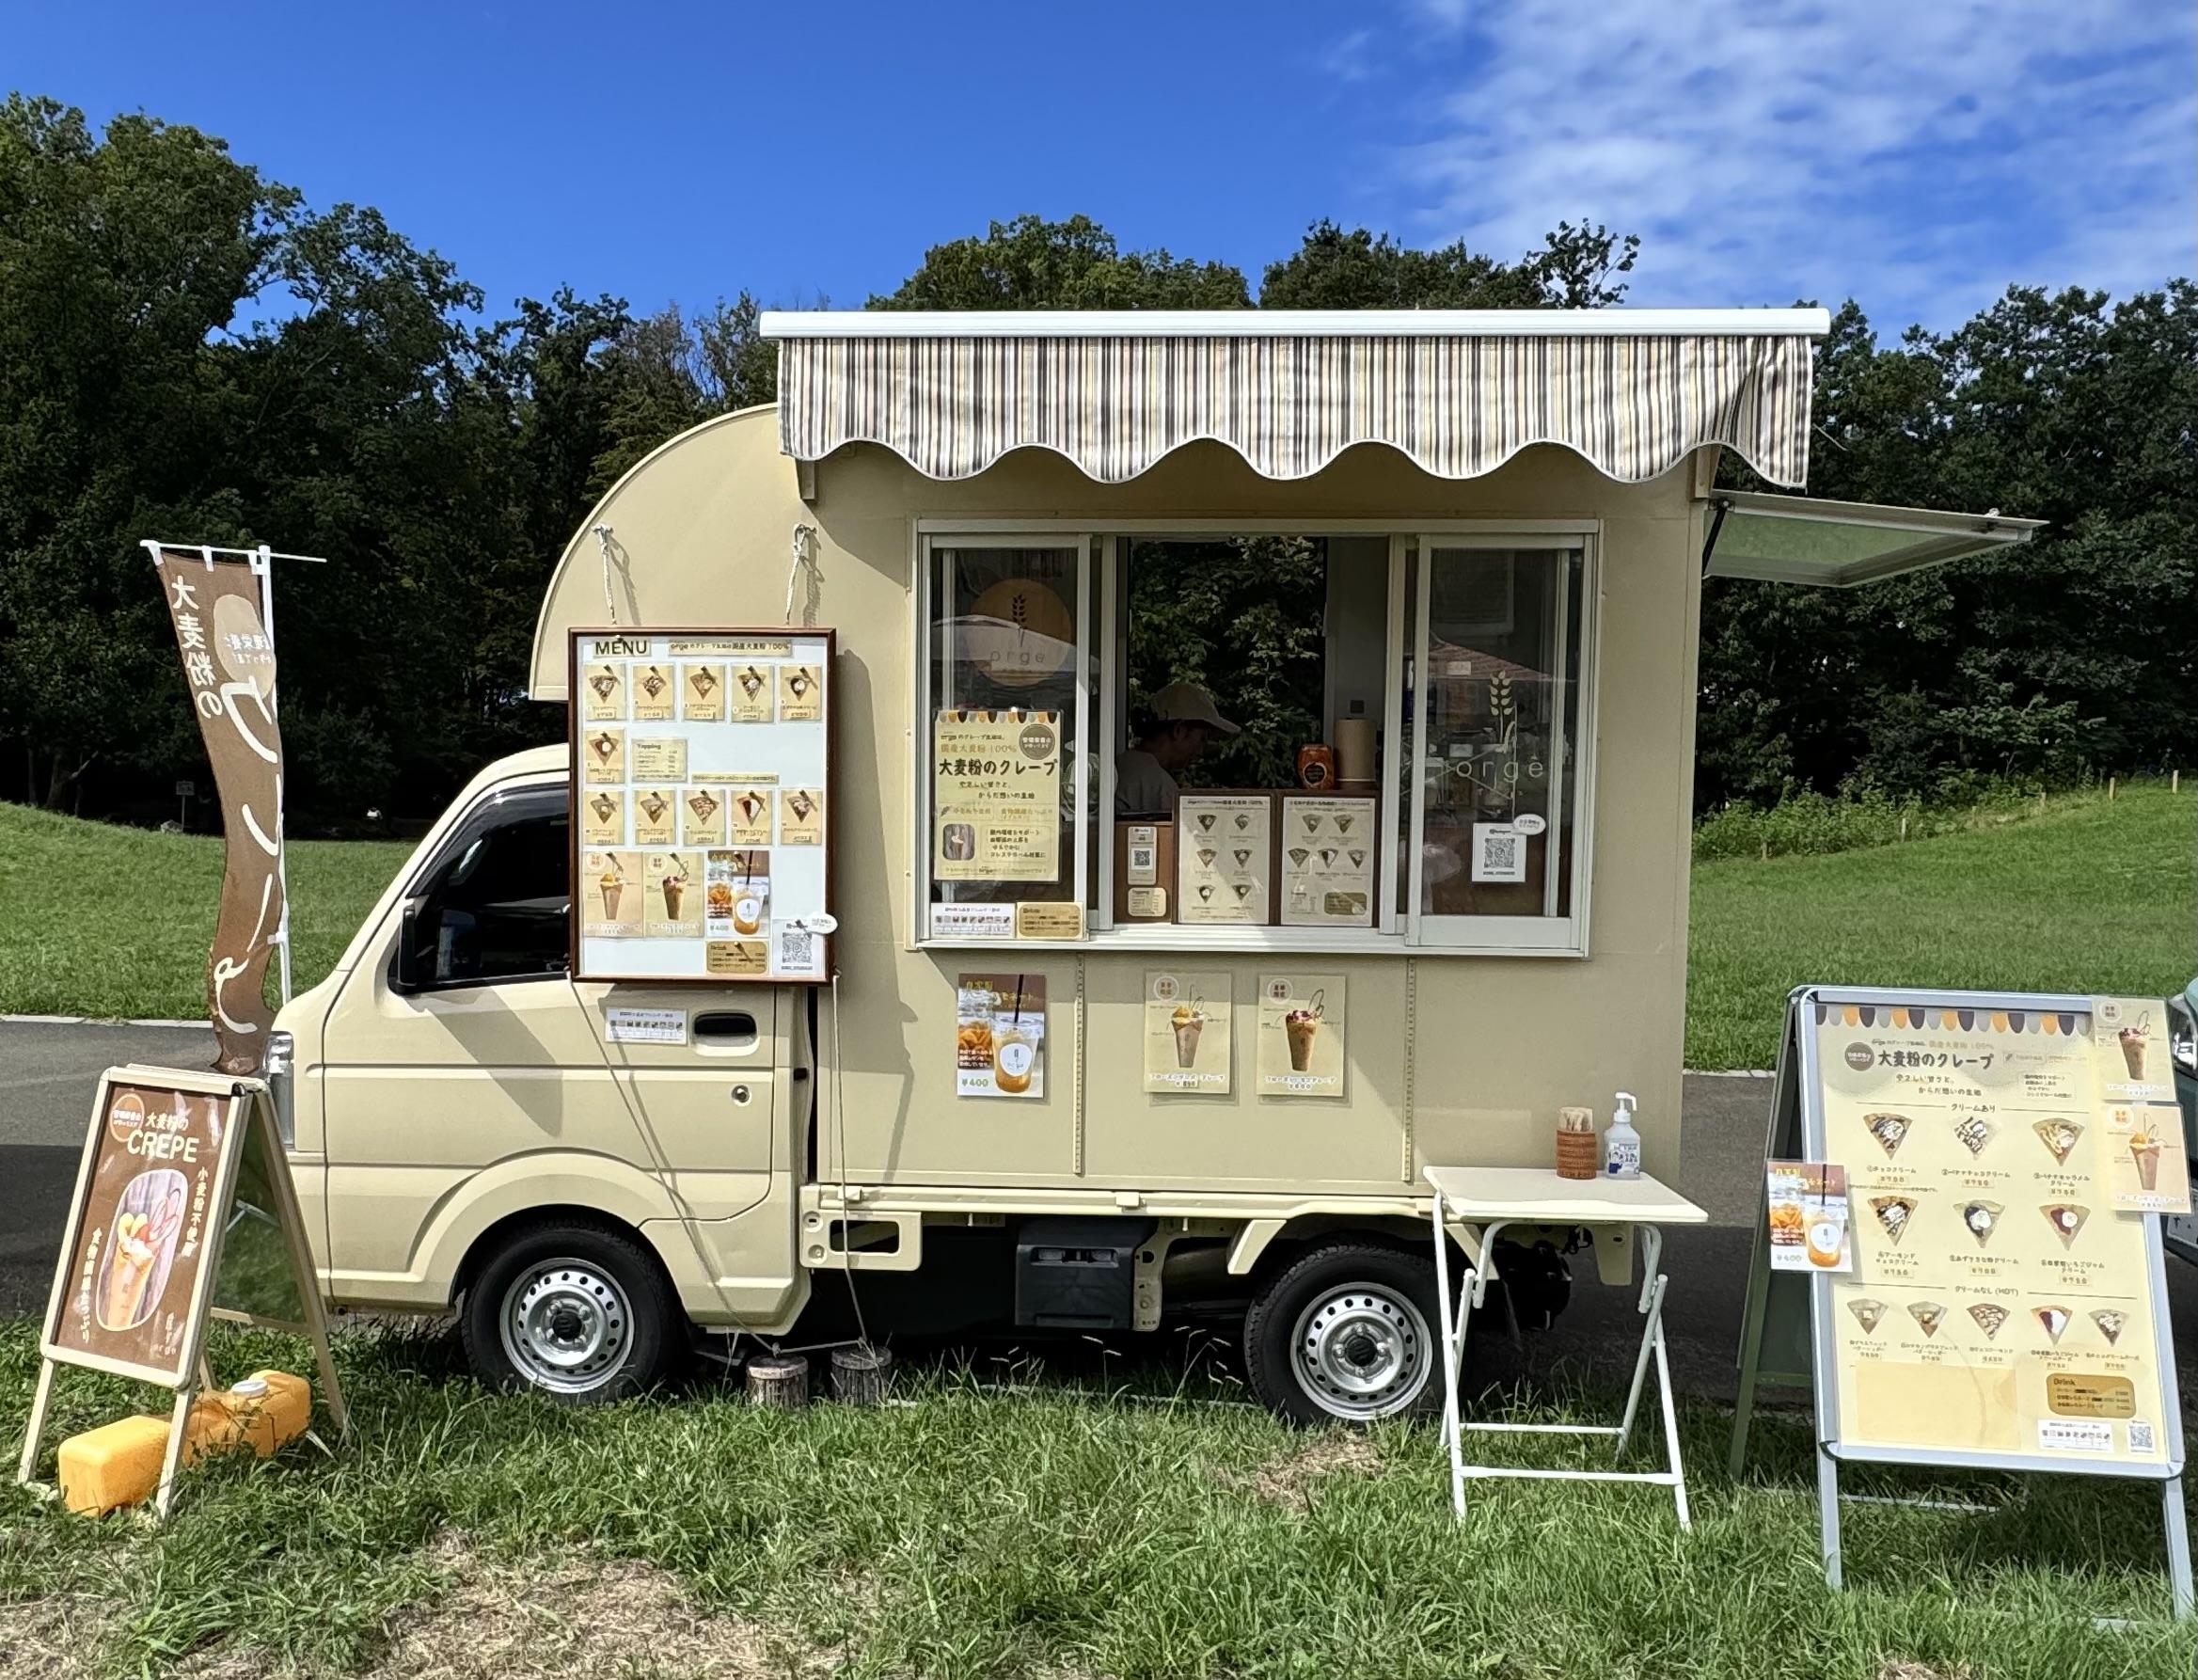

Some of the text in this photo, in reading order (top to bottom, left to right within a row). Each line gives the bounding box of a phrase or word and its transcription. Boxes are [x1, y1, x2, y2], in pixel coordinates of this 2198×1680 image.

[595, 641, 647, 655] MENU
[939, 758, 1058, 776] 大麦粉のクレープ
[1878, 1051, 1995, 1070] 大麦粉のクレープ
[961, 1078, 989, 1087] ¥400
[1952, 1102, 1996, 1112] クリームあり
[127, 1129, 200, 1164] CREPE
